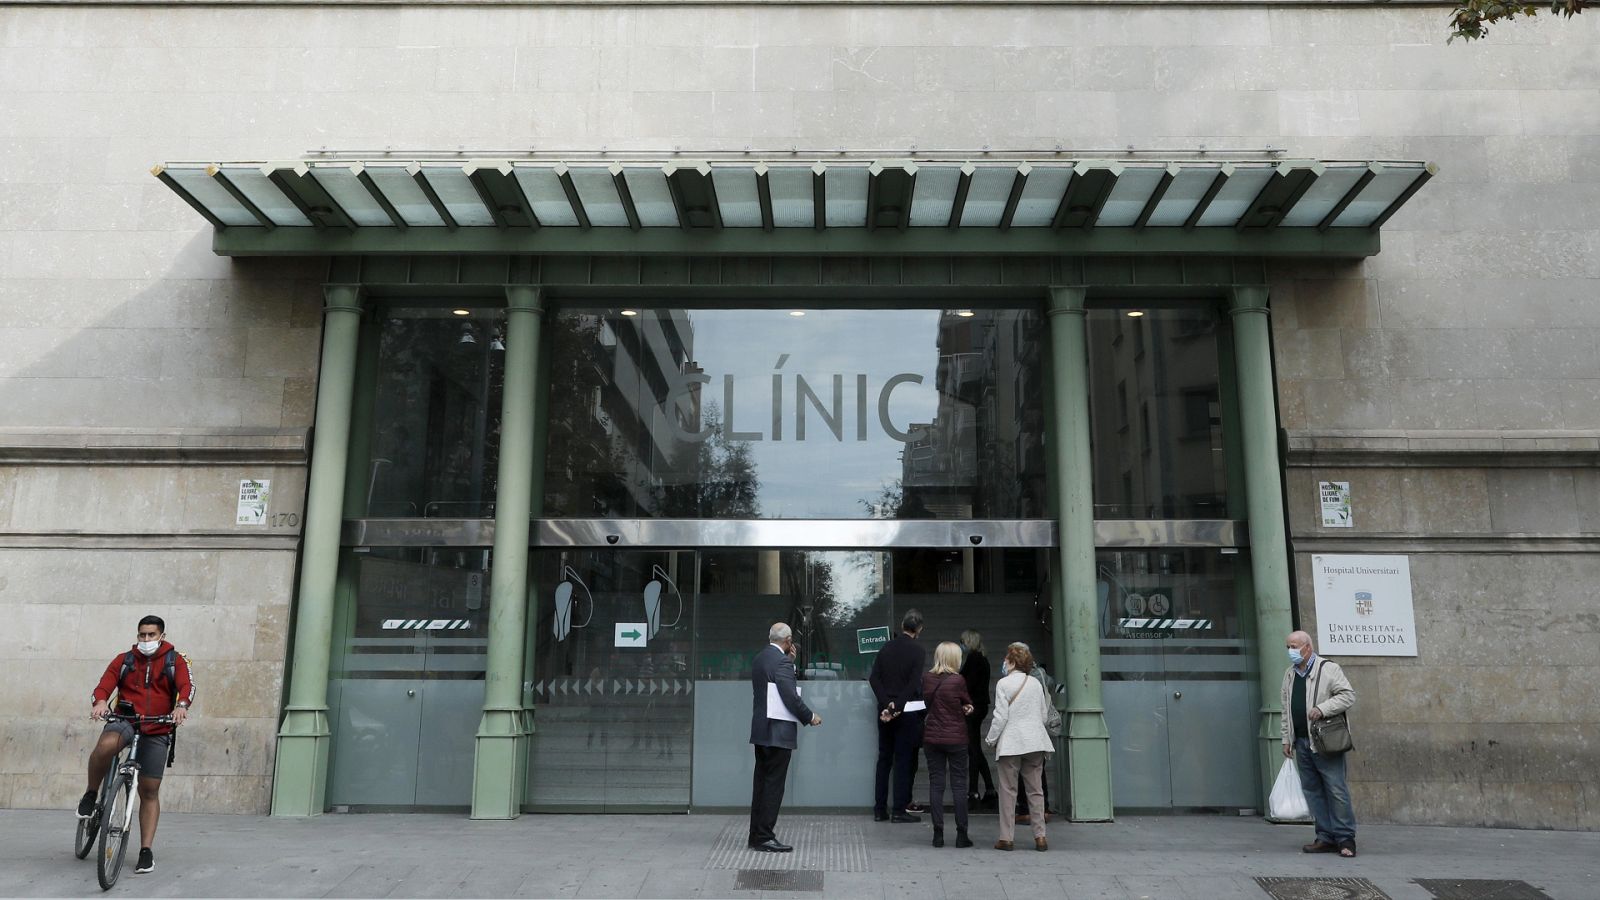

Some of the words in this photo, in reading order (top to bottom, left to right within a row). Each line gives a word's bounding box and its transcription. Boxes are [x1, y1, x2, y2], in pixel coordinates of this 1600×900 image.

[666, 354, 926, 443] CLÍNIC
[271, 512, 299, 527] 170
[1323, 566, 1354, 576] Hospital
[1356, 566, 1400, 575] Universitari
[1329, 623, 1396, 632] UNIVERSITAT
[861, 636, 886, 644] Entrada
[1329, 634, 1405, 644] BARCELONA
